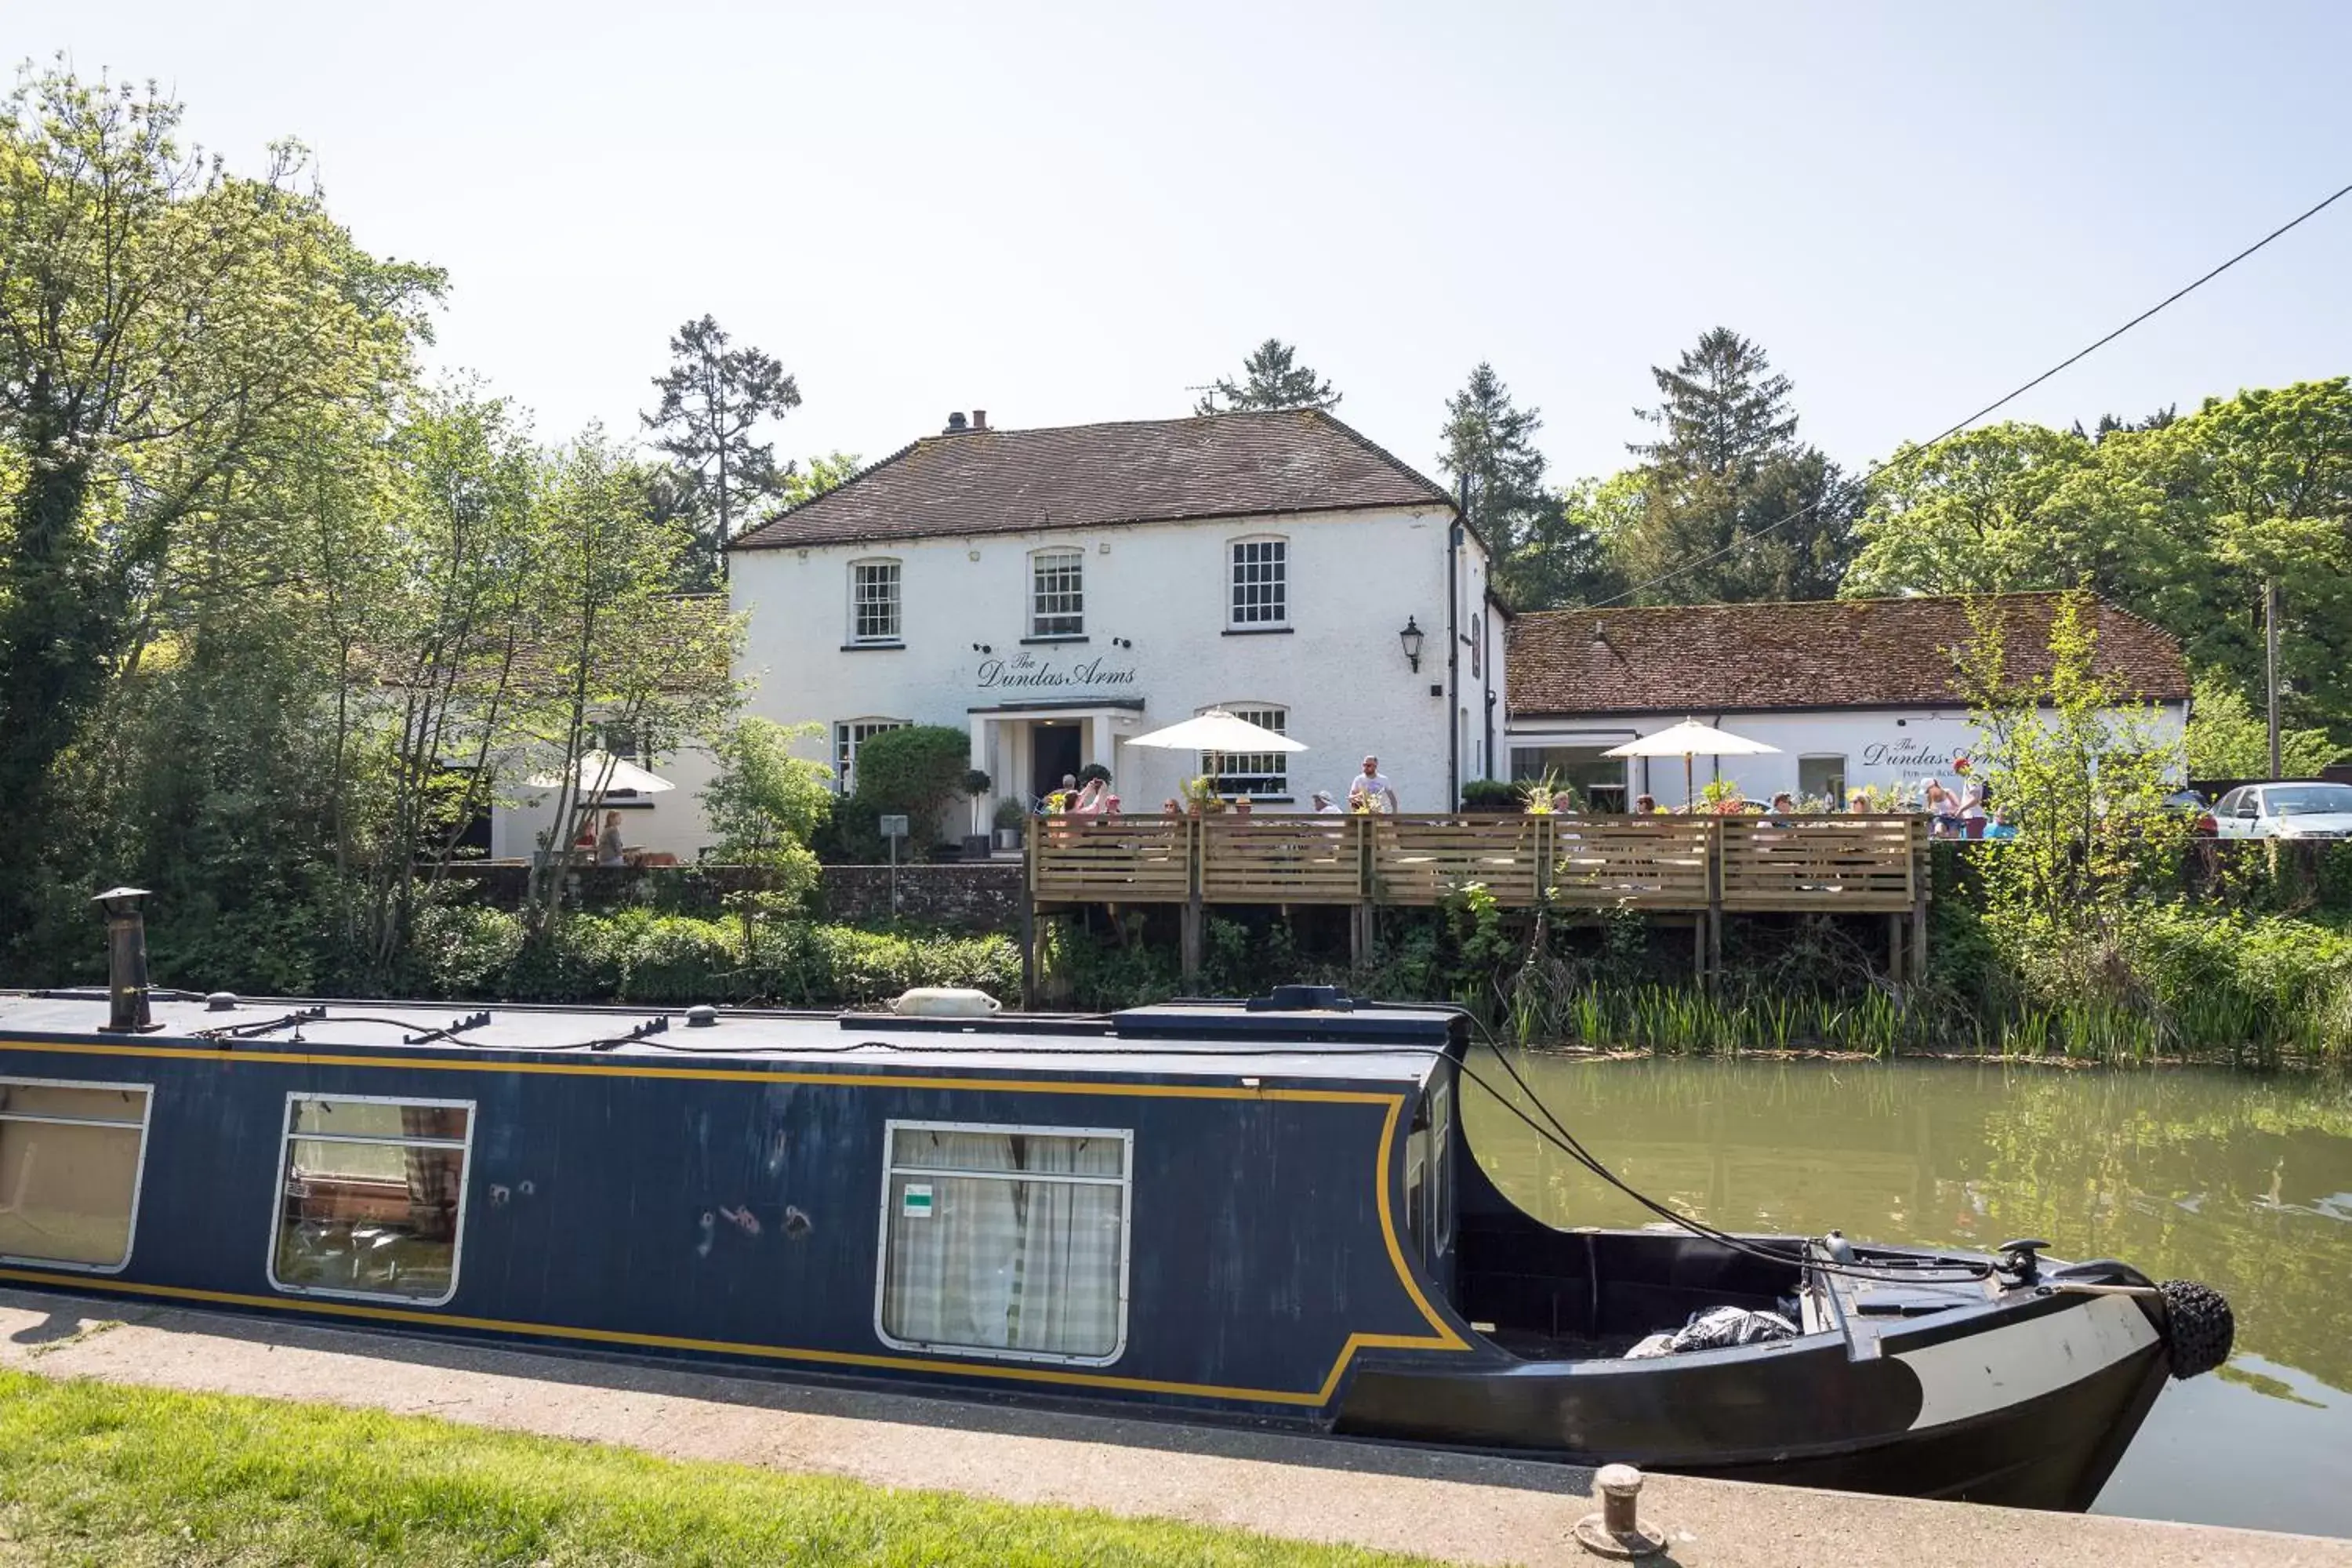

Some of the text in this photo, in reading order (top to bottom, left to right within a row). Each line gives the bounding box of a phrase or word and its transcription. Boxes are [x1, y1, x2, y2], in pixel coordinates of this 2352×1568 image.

[1011, 652, 1036, 669] The
[978, 655, 1136, 688] Dundas Arms
[1862, 742, 1944, 766] Dundas
[1893, 738, 1917, 751] The
